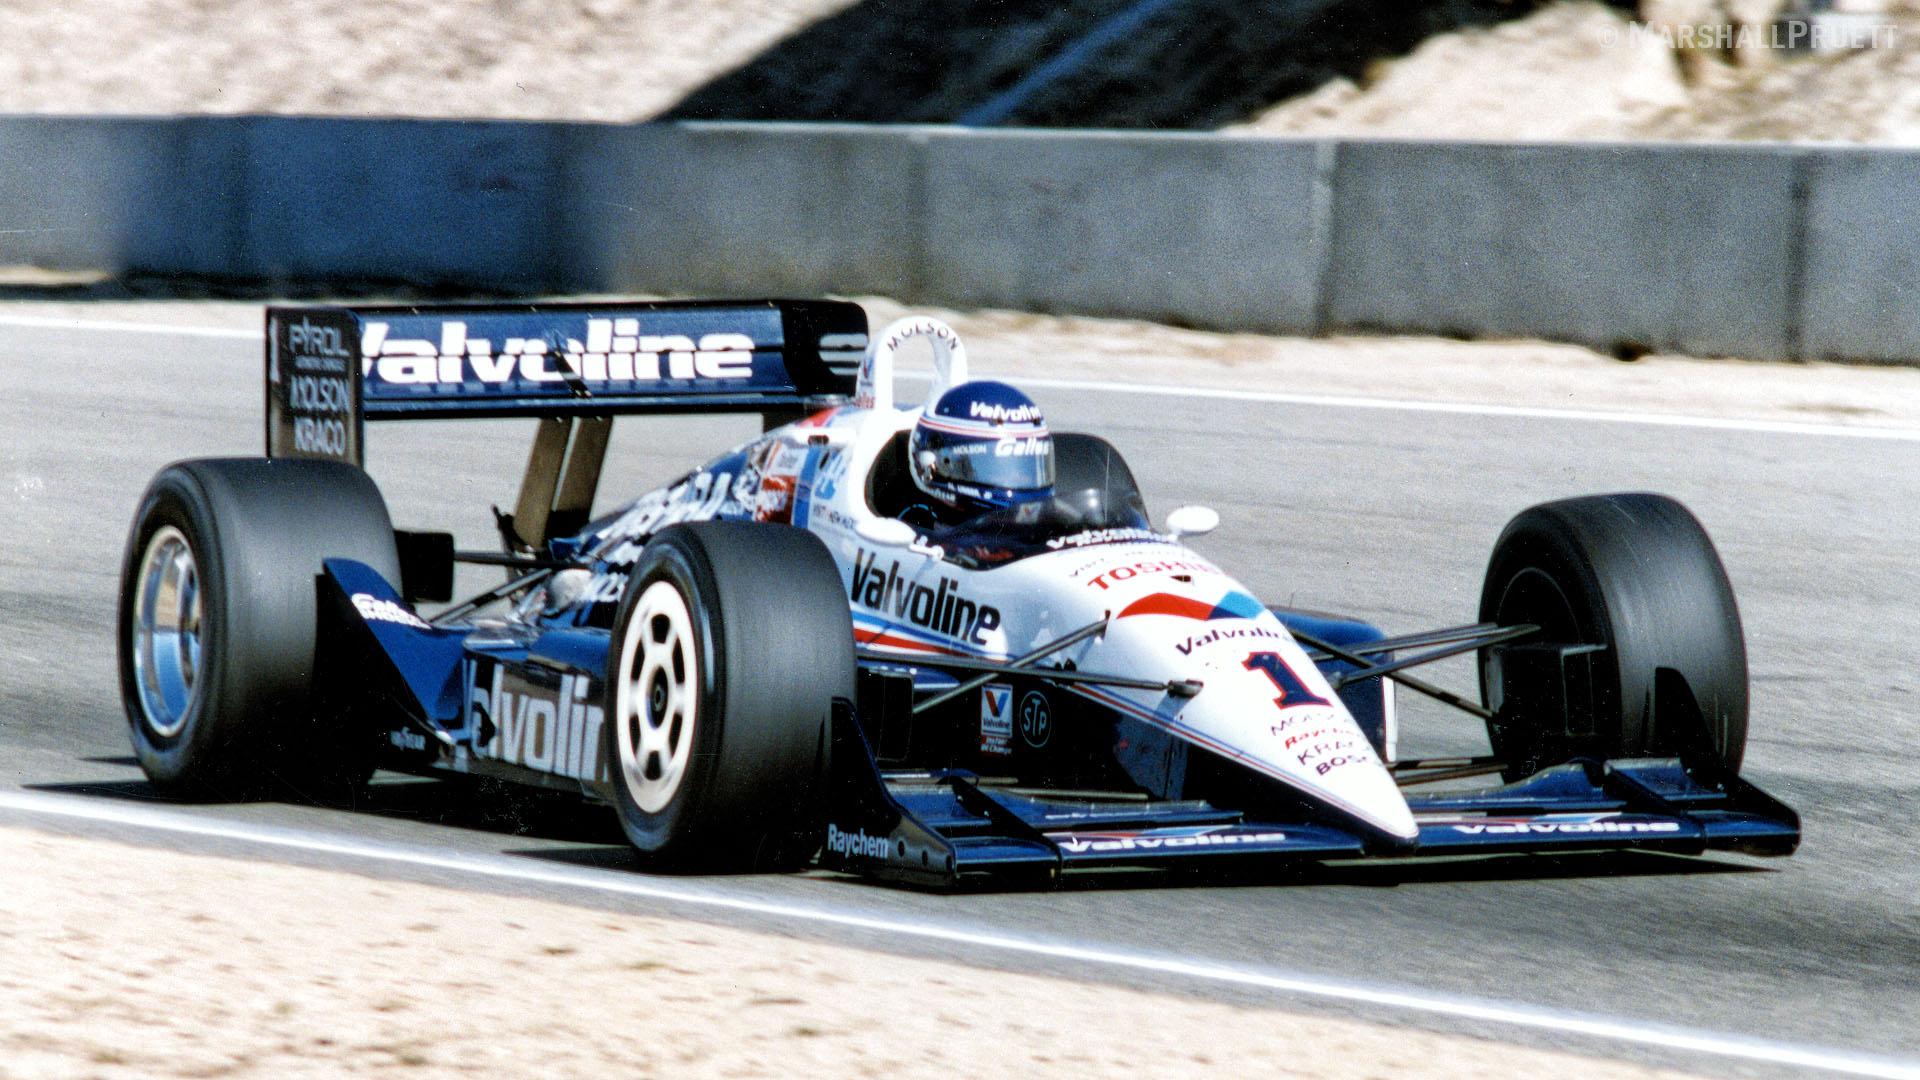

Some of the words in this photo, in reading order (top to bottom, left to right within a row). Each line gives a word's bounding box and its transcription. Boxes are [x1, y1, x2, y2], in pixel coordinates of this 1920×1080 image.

[887, 322, 958, 352] MOLSON
[290, 375, 350, 413] MOLSON
[970, 401, 1042, 421] Valvolin
[294, 416, 346, 456] KRACO
[1087, 560, 1222, 590] TOSHI
[851, 547, 1001, 646] Valvoline
[1175, 627, 1281, 656] Valvoli
[1241, 651, 1334, 710] 1
[454, 657, 609, 783] alvolin
[1023, 697, 1048, 737] STP
[1315, 754, 1368, 776] BOS
[827, 823, 889, 859] Raychem
[1057, 832, 1287, 853] Valvoline
[1451, 821, 1681, 834] Valvoline
